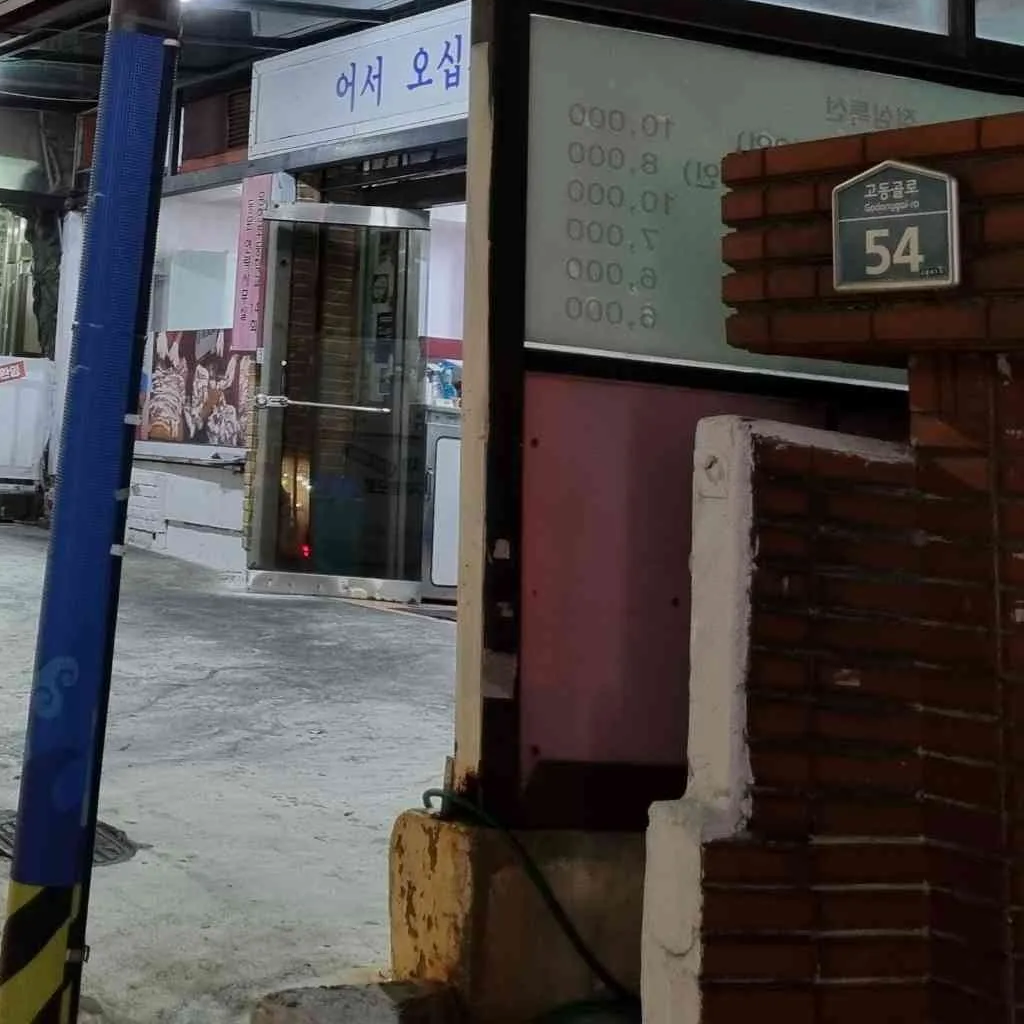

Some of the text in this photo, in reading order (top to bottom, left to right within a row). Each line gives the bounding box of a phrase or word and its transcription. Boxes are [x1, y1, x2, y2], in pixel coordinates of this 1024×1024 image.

[336, 34, 462, 113] 어서 오십
[864, 179, 920, 201] 고동골로
[865, 226, 925, 275] 54
